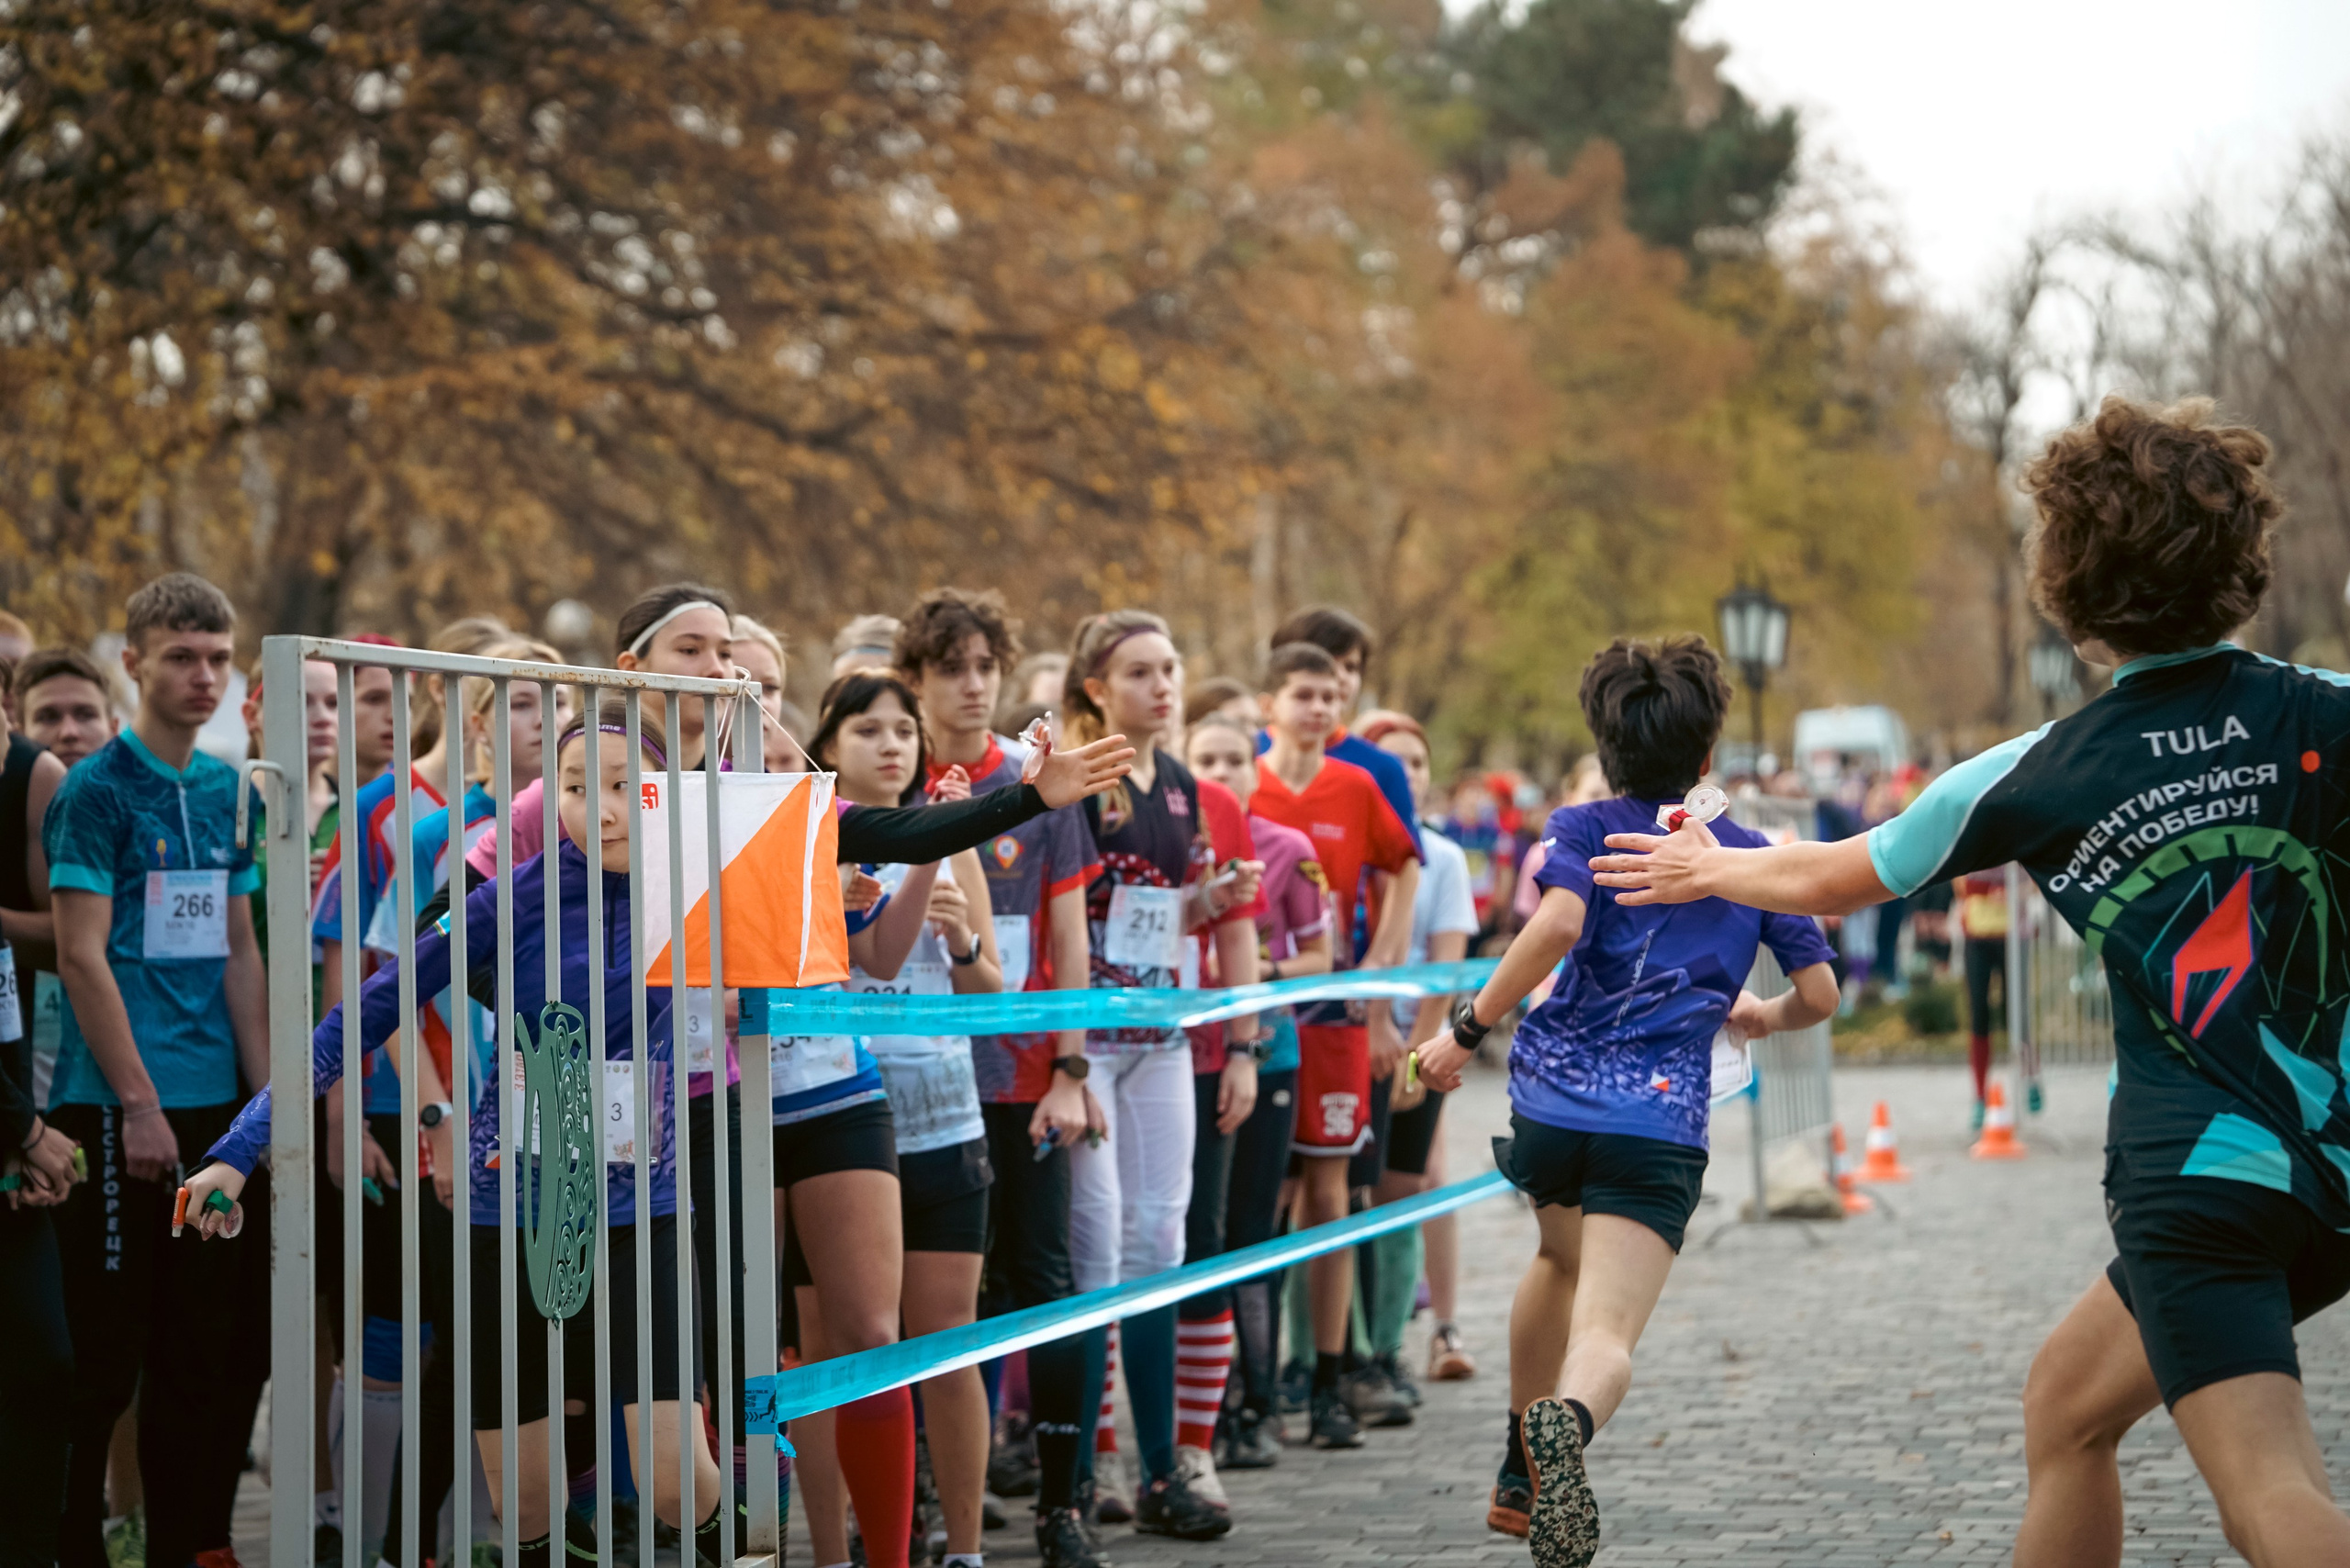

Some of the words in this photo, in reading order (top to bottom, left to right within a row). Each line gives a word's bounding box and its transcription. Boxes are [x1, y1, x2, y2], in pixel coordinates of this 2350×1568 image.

[2141, 715, 2251, 757] TULA
[2048, 763, 2278, 893] ОРИЕНТИРУЙСЯ
[2079, 856, 2121, 893] НА
[2117, 794, 2260, 859] ПОБЕДУ!
[173, 892, 214, 919] 266
[688, 1014, 700, 1034] 3
[610, 1102, 623, 1122] 3
